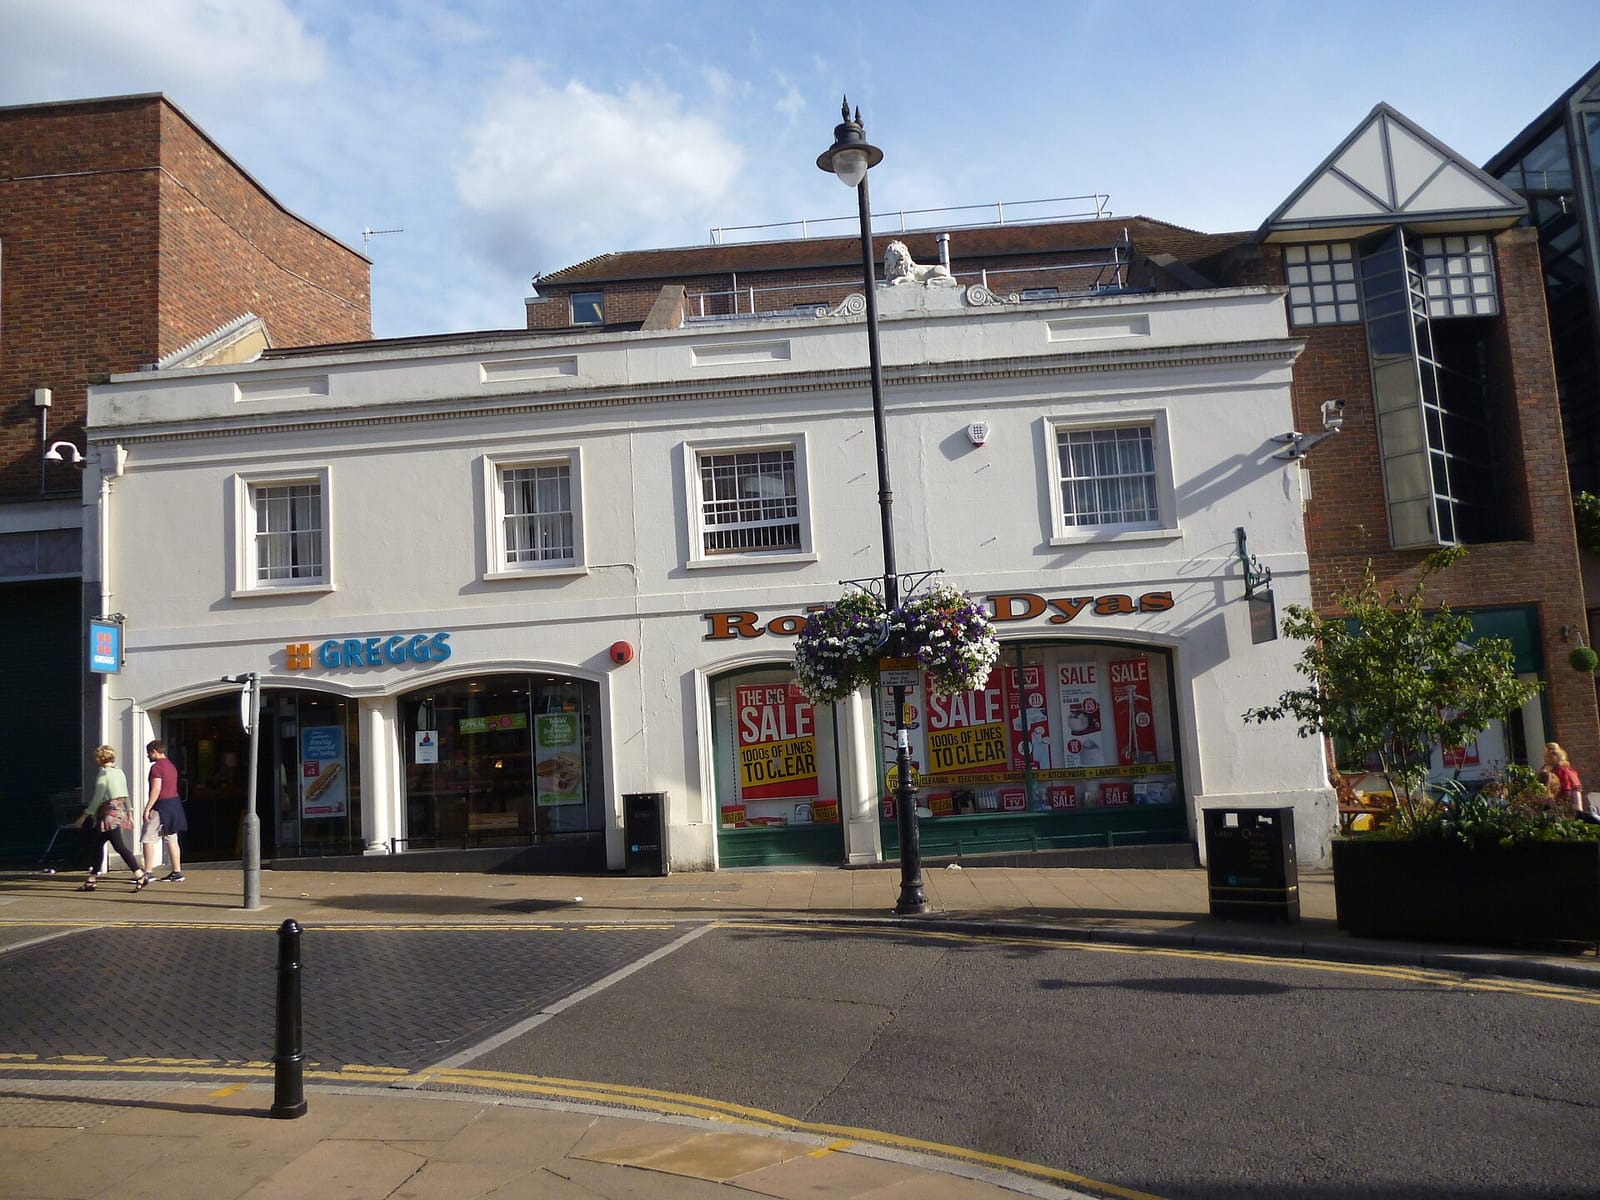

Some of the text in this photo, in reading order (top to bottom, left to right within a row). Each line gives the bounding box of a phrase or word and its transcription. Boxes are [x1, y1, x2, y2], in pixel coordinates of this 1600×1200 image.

[986, 591, 1175, 624] Dyas
[319, 632, 453, 669] GREGGS
[1061, 666, 1096, 685] SALE
[1111, 662, 1147, 683] SALE
[740, 688, 785, 706] THE BIG
[930, 688, 1002, 729] SALE
[741, 703, 813, 743] SALE
[931, 726, 1002, 748] 1000s OF LINES
[742, 740, 813, 762] 1000s OF LINES
[933, 747, 954, 769] TO
[956, 740, 1006, 765] CLEAR
[743, 761, 764, 782] TO
[1053, 794, 1075, 808] SALE
[1106, 791, 1129, 804] SALE
